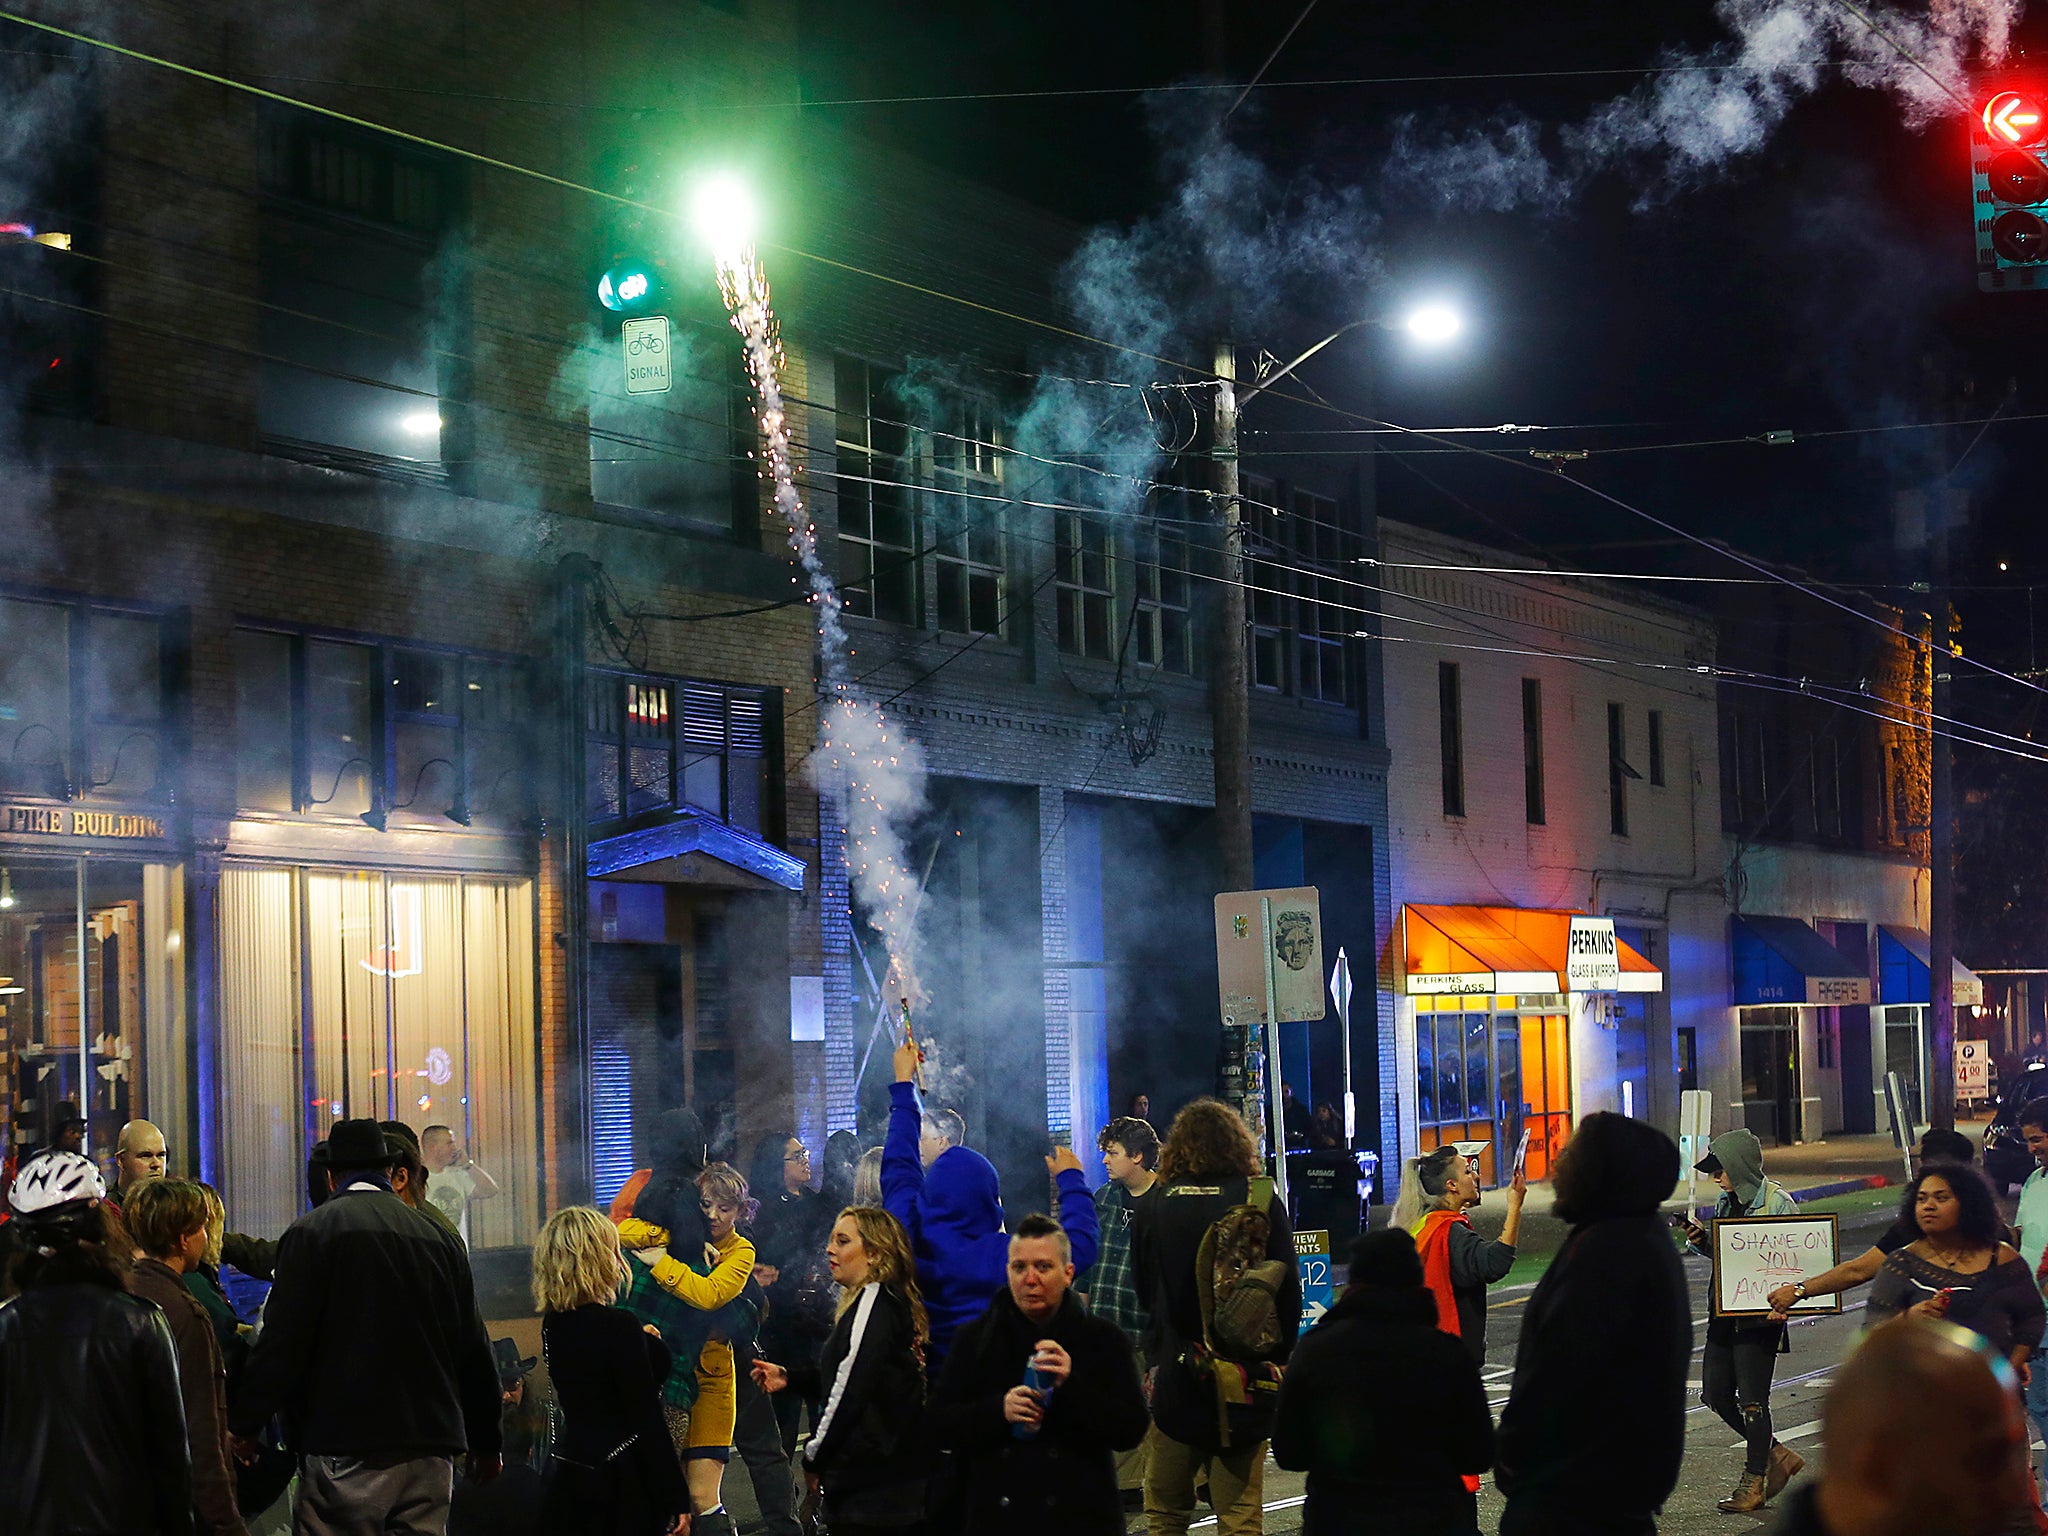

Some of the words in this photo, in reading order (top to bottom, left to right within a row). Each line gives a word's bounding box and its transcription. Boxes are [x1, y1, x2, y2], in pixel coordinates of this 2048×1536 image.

[630, 366, 666, 380] SIGNAL
[8, 808, 63, 833] PIKE
[72, 811, 165, 838] BUILDING
[1572, 929, 1614, 955] PERKINS
[1571, 963, 1589, 978] GLASS
[1595, 963, 1616, 978] MIRROR
[1416, 975, 1463, 985] PERKINS
[1449, 983, 1486, 993] GLASS
[1757, 986, 1784, 998] 1414
[1306, 1169, 1336, 1177] GARBAGE
[1730, 1231, 1799, 1252] SHAME
[1803, 1228, 1829, 1250] ON
[1758, 1251, 1799, 1272] YOU
